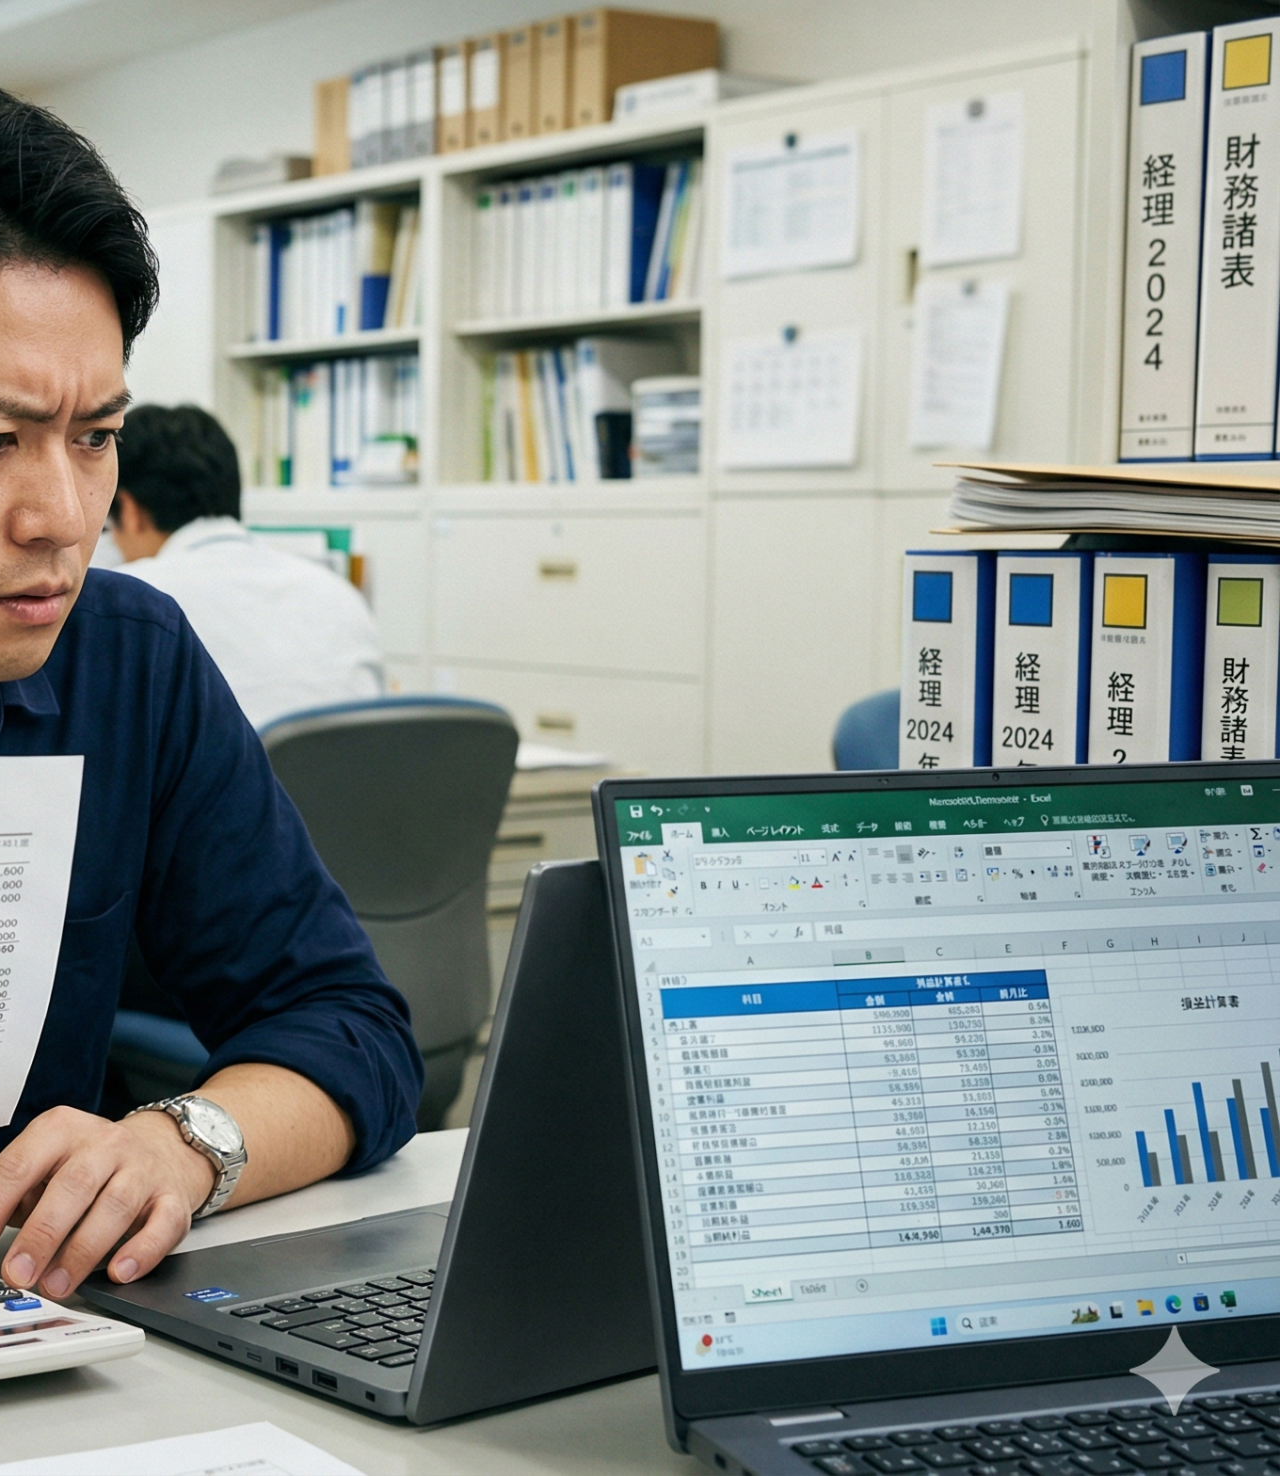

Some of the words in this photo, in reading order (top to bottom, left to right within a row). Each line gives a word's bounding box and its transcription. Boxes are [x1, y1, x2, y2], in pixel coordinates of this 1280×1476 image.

[1141, 153, 1177, 227] 経理
[1220, 132, 1261, 290] 財務諸表
[1144, 238, 1167, 371] 2024
[918, 646, 944, 708] 経理
[1014, 652, 1041, 715] 経理
[1106, 670, 1136, 737] 経理
[906, 718, 955, 743] 2024
[1001, 725, 1055, 751] 2024
[746, 955, 755, 965] A
[865, 951, 873, 961] B
[935, 947, 944, 957] C
[1005, 943, 1013, 954] E
[1061, 941, 1069, 950] F
[1106, 939, 1116, 949] G
[1150, 937, 1159, 947] H
[1240, 933, 1247, 942] J
